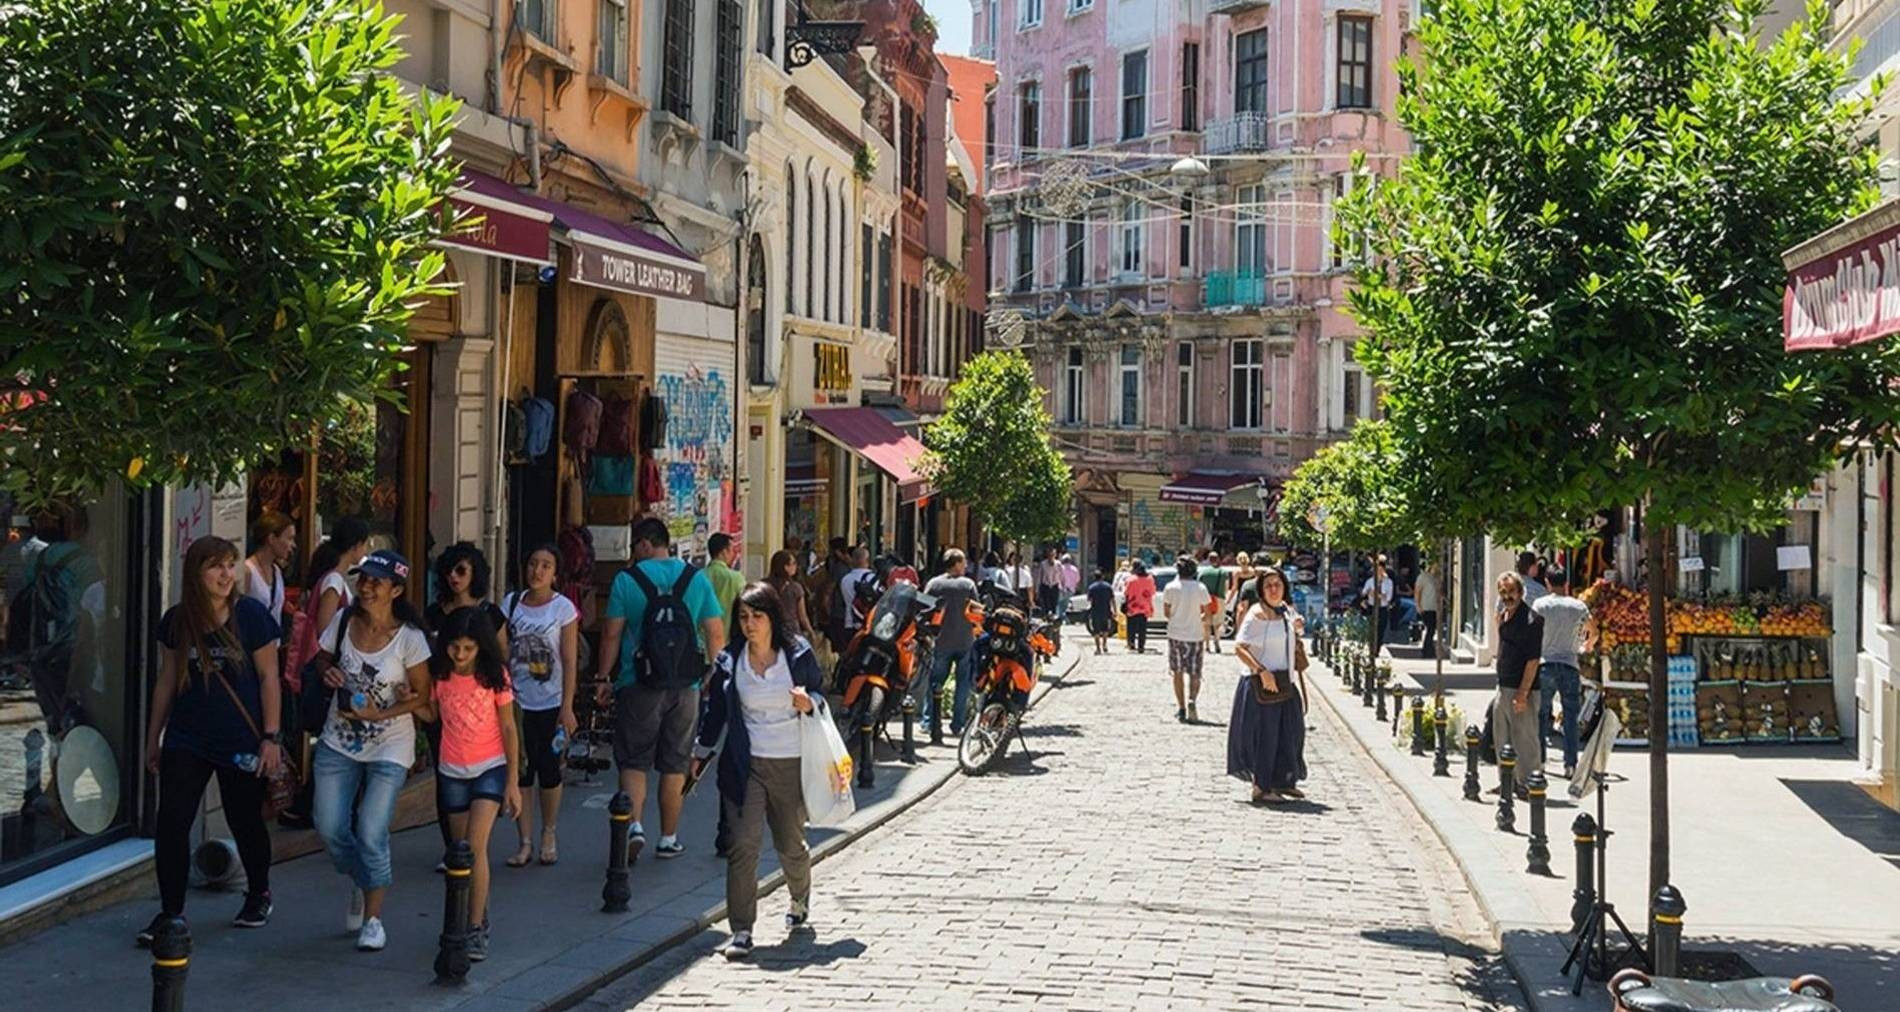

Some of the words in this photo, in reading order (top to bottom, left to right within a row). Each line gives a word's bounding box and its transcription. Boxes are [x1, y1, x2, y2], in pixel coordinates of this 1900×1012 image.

[602, 254, 635, 284] TOWER
[637, 262, 676, 292] LEATHER
[676, 272, 693, 296] BAG
